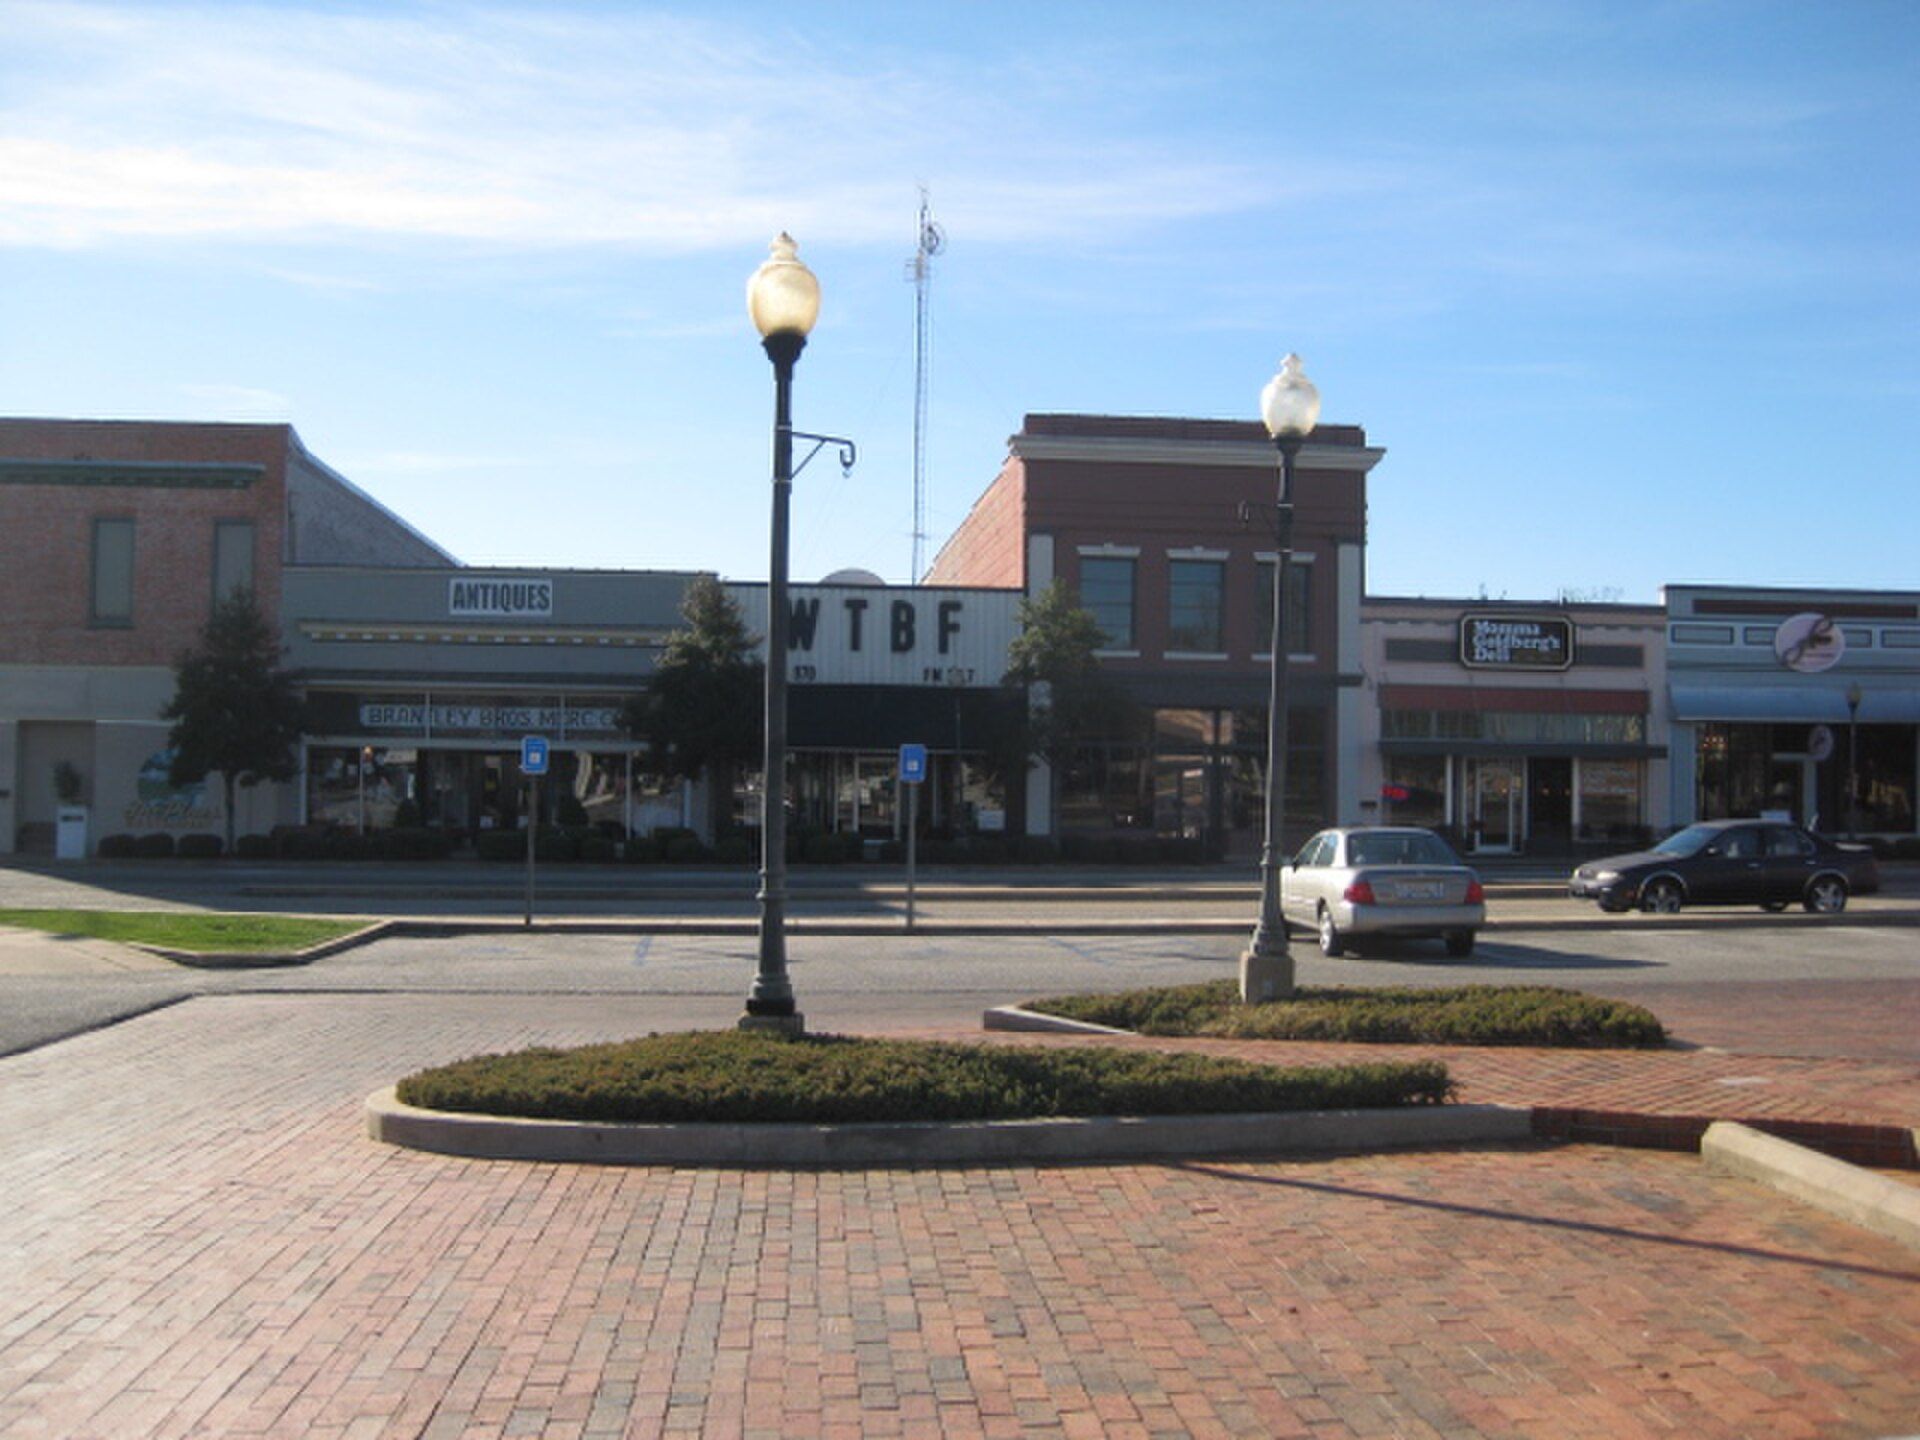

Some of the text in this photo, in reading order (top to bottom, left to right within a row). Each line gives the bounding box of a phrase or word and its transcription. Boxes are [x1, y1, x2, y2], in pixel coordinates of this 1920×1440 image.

[454, 582, 550, 612] ANTIQUES
[787, 597, 963, 654] WTBF
[368, 707, 472, 725] BRANLEY
